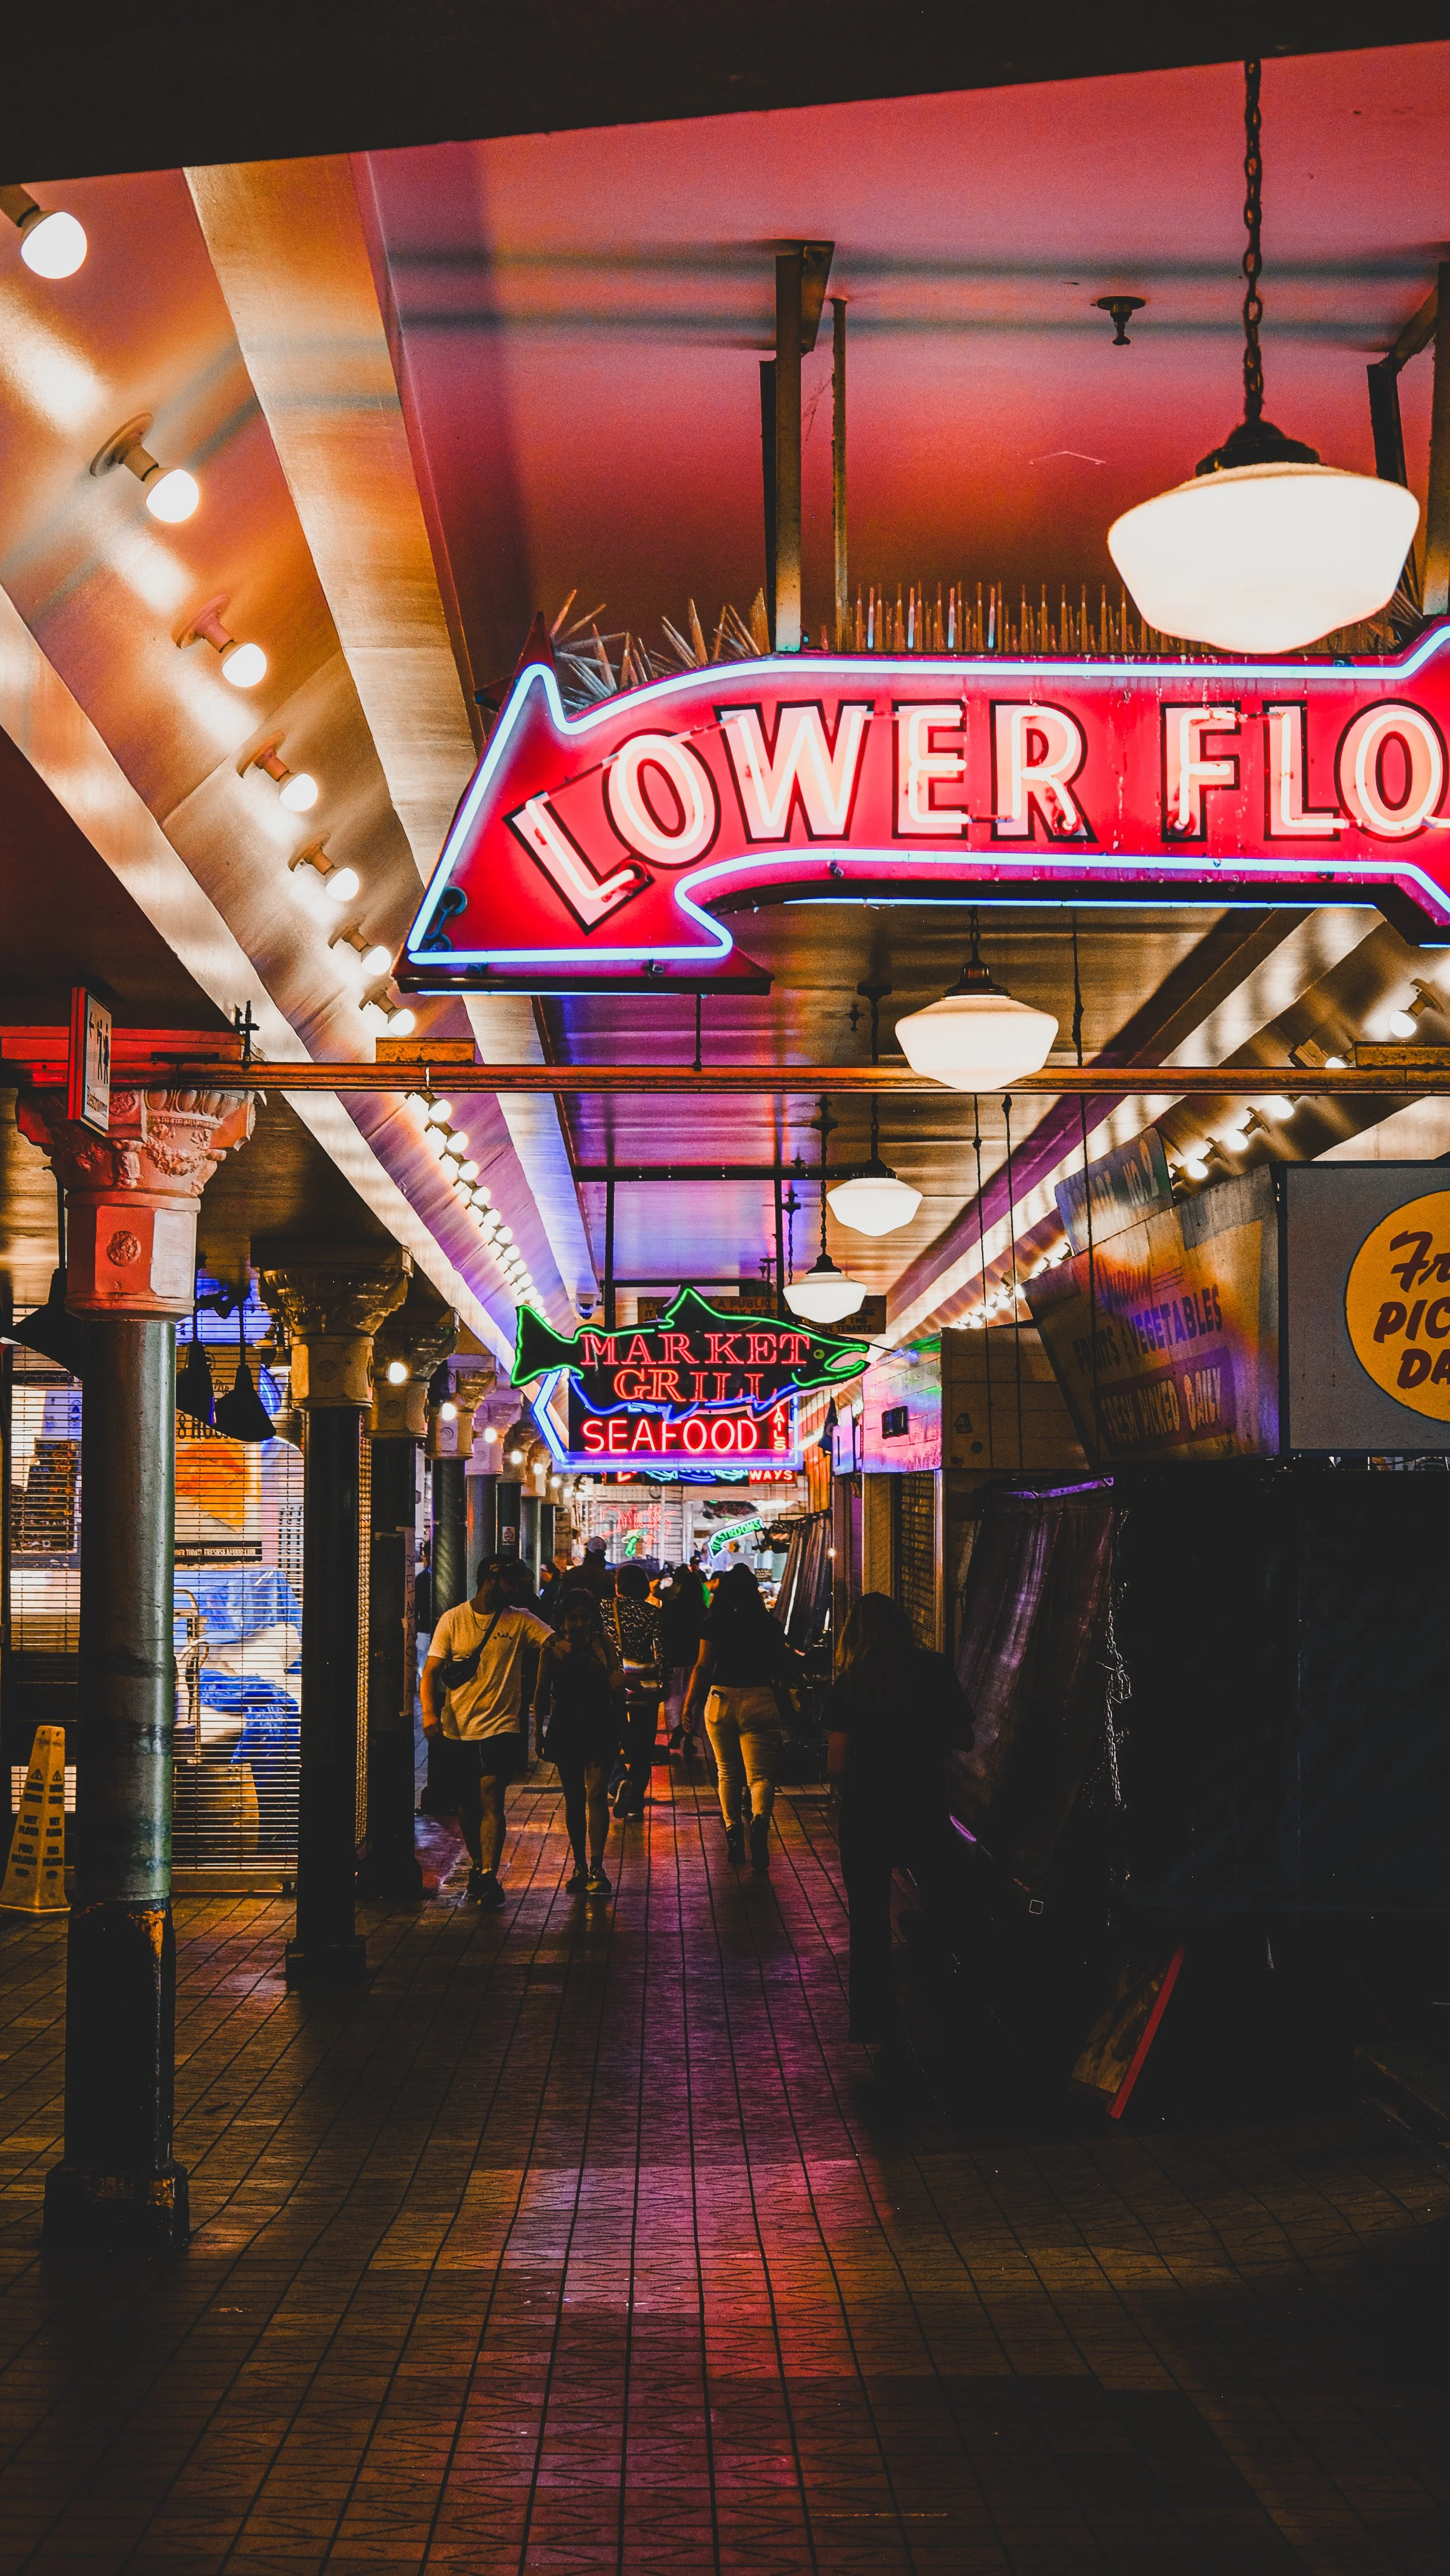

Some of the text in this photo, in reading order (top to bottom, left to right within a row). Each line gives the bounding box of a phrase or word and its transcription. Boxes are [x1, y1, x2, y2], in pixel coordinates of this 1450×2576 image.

[502, 698, 1449, 935] LOWER FLO
[1126, 1283, 1223, 1356] VEGETABLES
[1373, 1297, 1450, 1344] PIC
[579, 1333, 810, 1365] MARKET
[614, 1369, 777, 1403] GRILL
[1137, 1380, 1180, 1435] PICKED
[1184, 1366, 1221, 1431] DAILY
[583, 1418, 758, 1452] SEAFOOD
[710, 1519, 762, 1551] RESTROOMS
